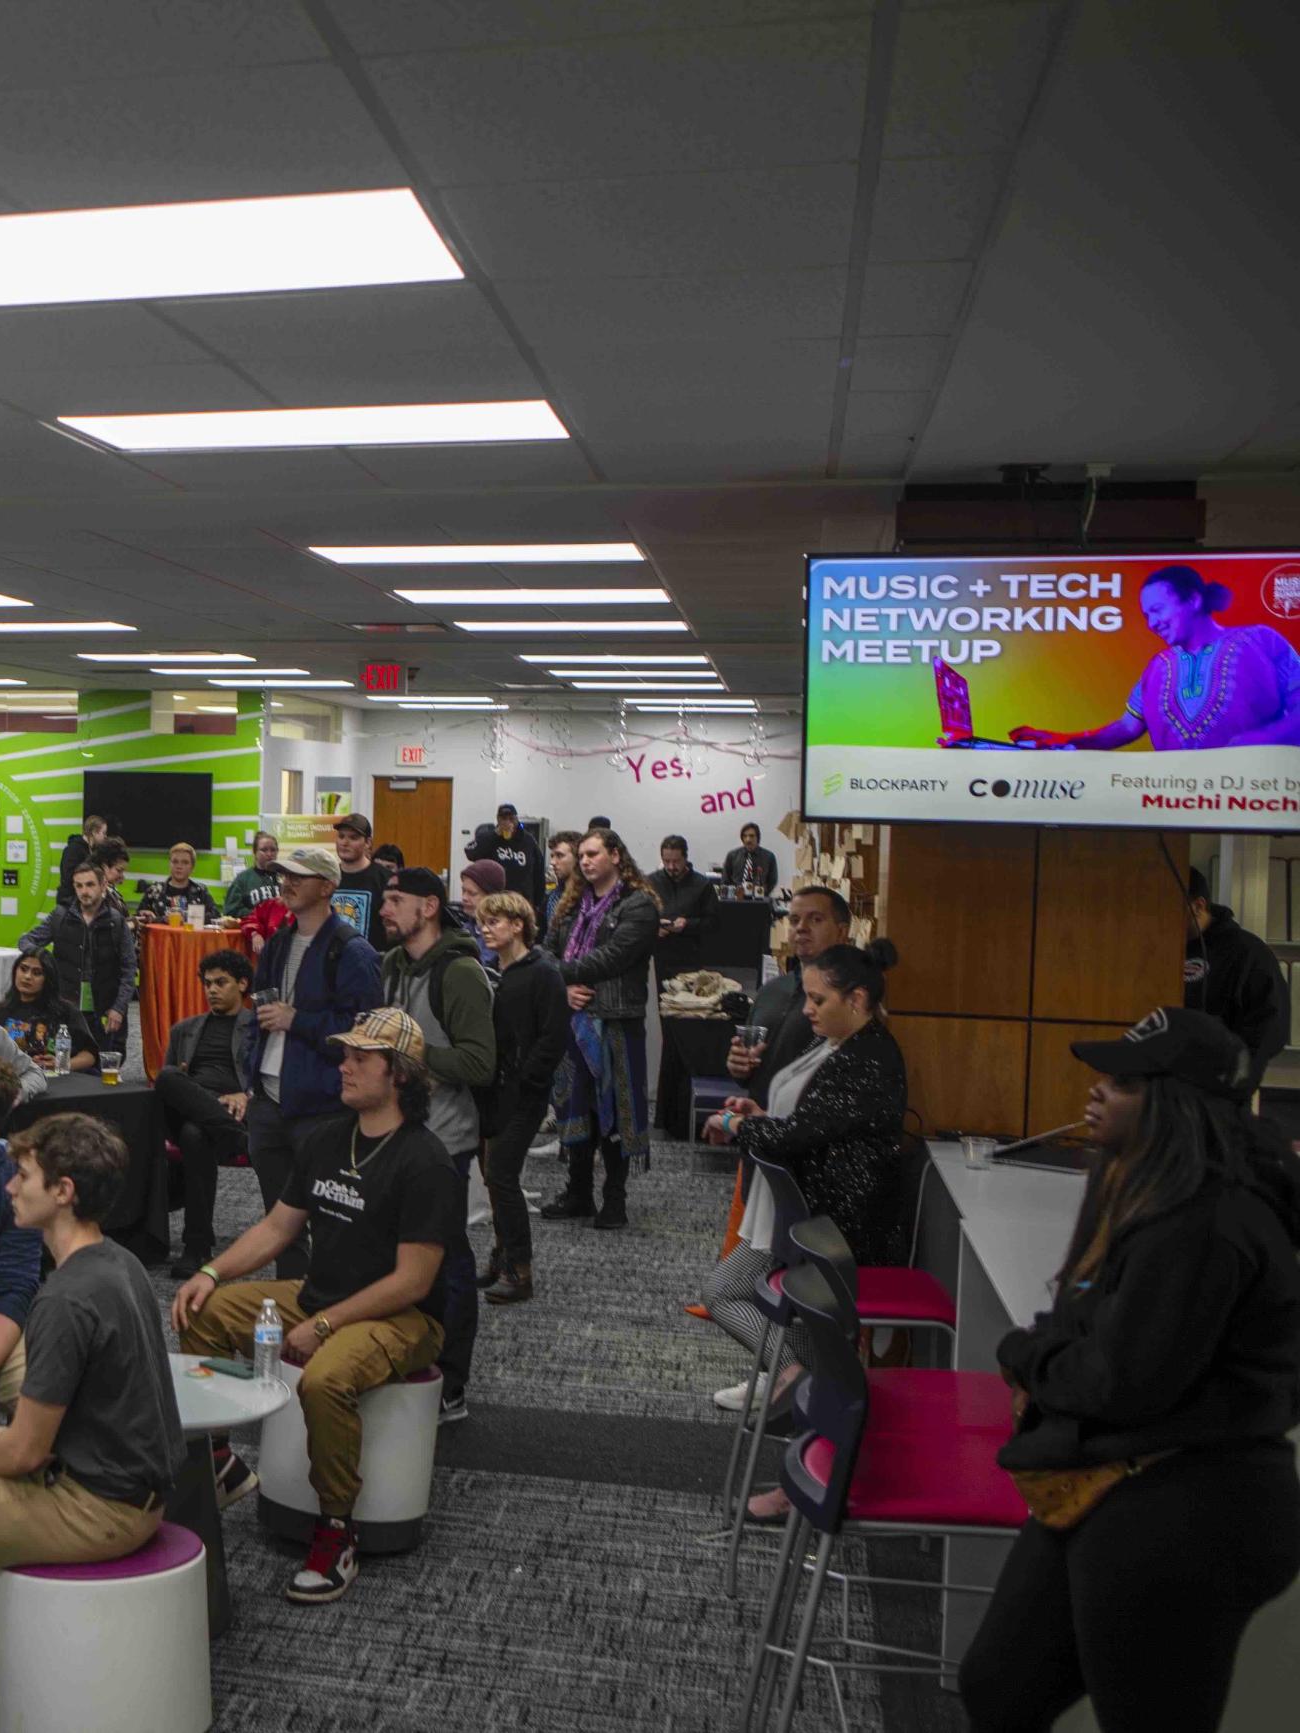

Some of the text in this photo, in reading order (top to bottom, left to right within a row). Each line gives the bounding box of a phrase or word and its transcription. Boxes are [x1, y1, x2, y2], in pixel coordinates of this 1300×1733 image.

[822, 573, 1122, 600] MUSIC + TECH
[822, 606, 1123, 632] NETWORKING
[821, 639, 1002, 664] MEETUP
[366, 664, 401, 690] EXIT
[402, 747, 423, 763] EXIT
[626, 753, 692, 783] Yes,
[850, 778, 949, 792] BLOCKPARTY
[1110, 773, 1197, 792] Featuring
[1203, 778, 1214, 790] a
[1220, 775, 1244, 790] DJ
[1250, 777, 1279, 791] set
[701, 778, 755, 814] and
[1141, 794, 1300, 812] Muchi Noch
